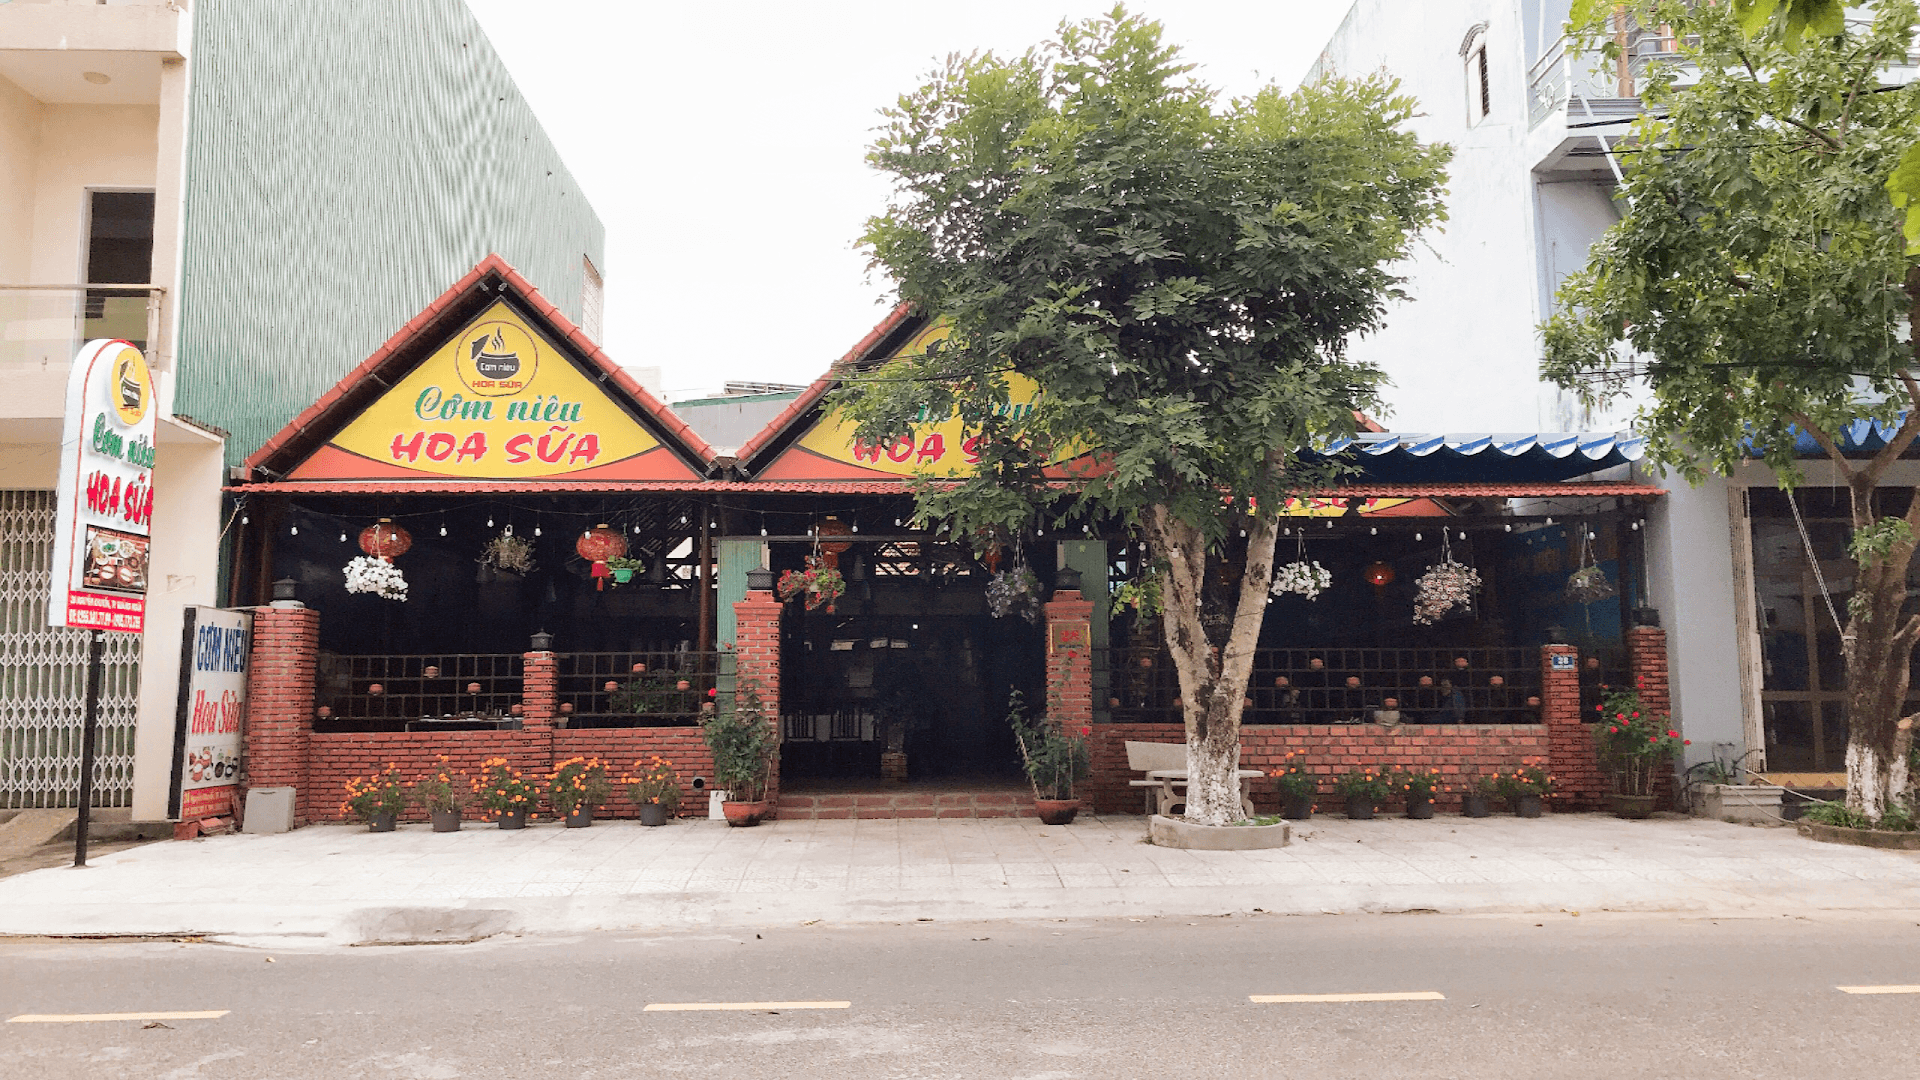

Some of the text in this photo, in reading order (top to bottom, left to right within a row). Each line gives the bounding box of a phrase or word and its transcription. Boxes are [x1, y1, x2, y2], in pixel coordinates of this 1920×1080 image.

[415, 386, 583, 422] Cơm niêu
[390, 425, 600, 465] HOA SỮA
[87, 469, 121, 518] HOA
[191, 689, 218, 734] Hoa
